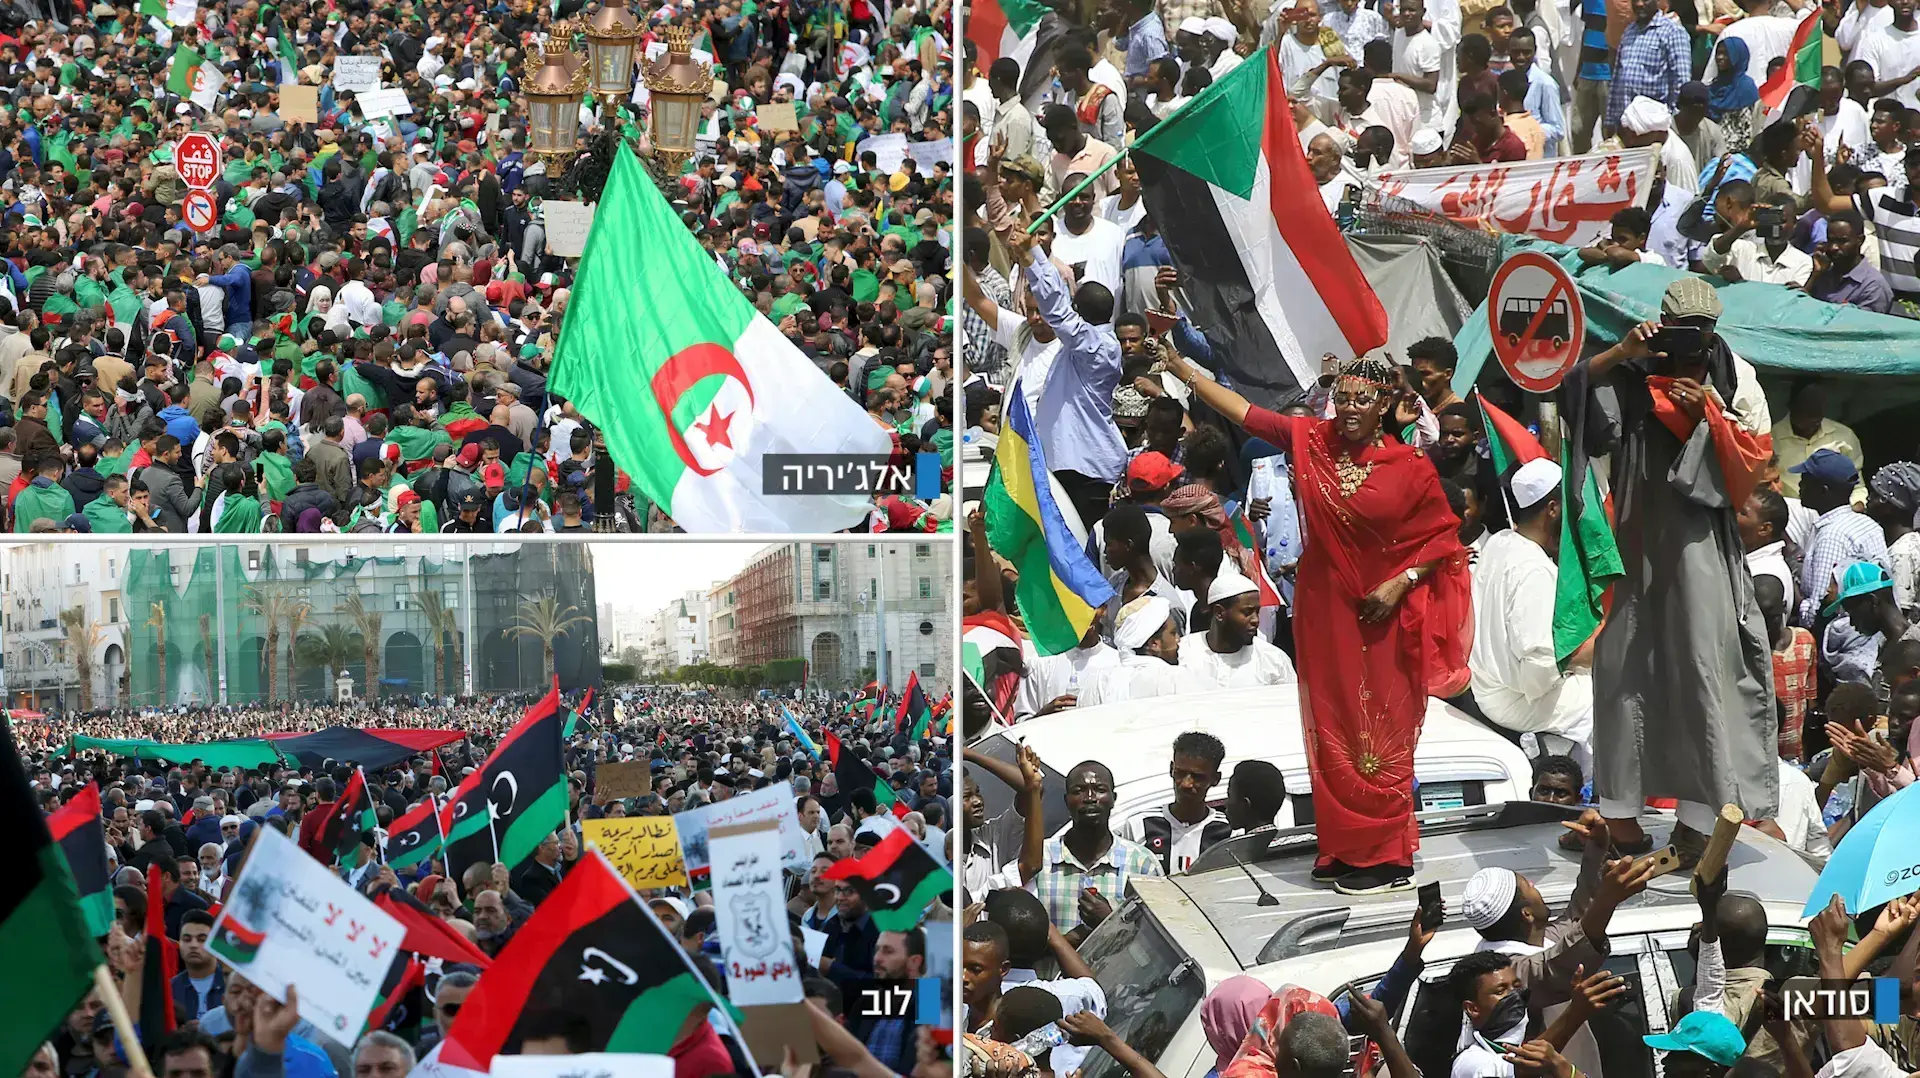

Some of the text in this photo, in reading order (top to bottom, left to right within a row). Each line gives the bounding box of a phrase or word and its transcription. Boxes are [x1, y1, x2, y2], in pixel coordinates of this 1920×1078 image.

[182, 143, 213, 165] قف
[183, 163, 213, 179] STOP
[324, 901, 344, 926] لا
[346, 918, 366, 942] لا
[369, 935, 388, 960] لا
